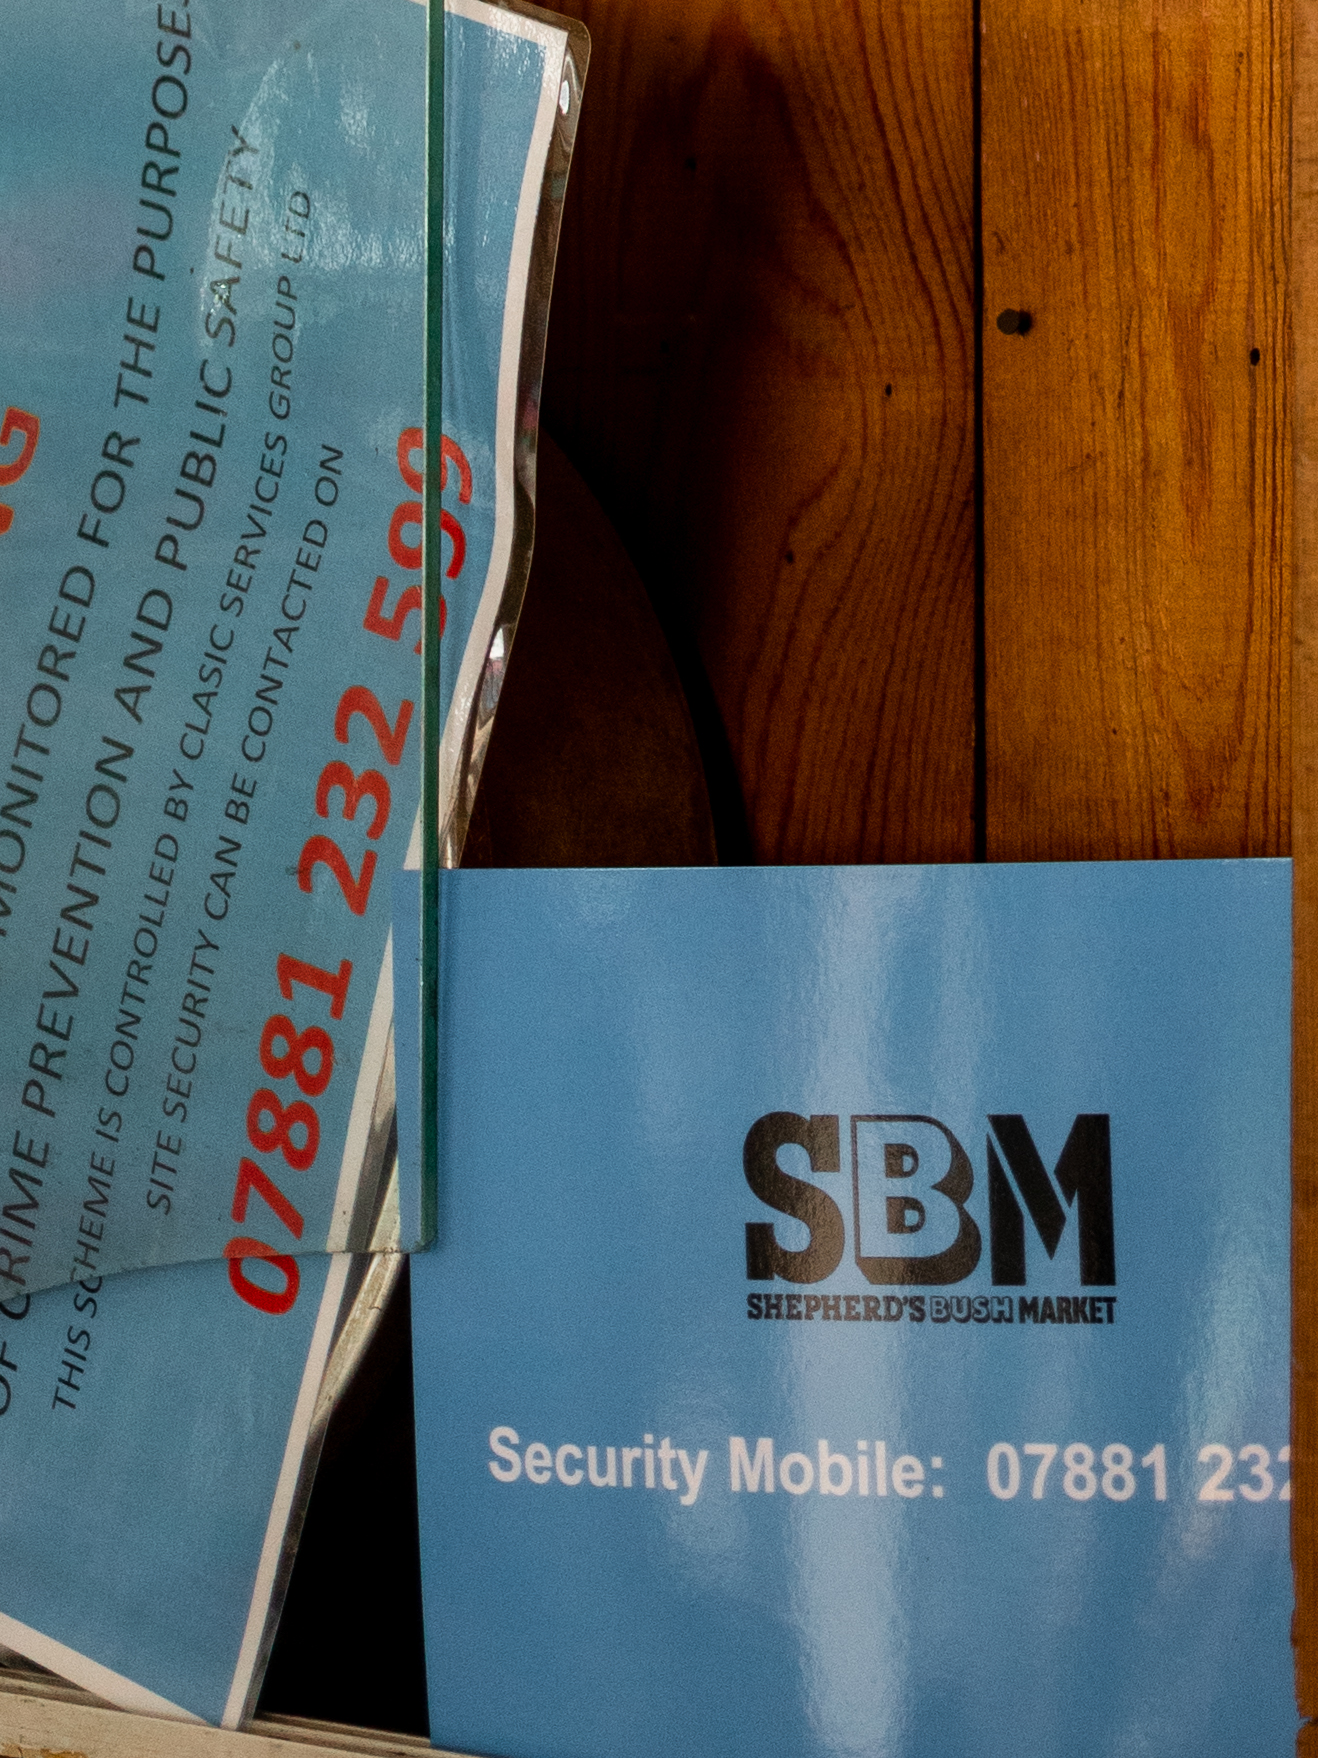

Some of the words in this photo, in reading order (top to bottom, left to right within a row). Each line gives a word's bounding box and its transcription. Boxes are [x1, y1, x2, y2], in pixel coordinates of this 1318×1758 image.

[281, 191, 311, 264] LTD
[268, 275, 298, 421] GROUP
[77, 431, 141, 548] FOR
[113, 297, 163, 408] THE
[315, 443, 344, 506] ON
[219, 431, 288, 617] SERVICES
[21, 735, 135, 1118] PREVENTION
[114, 588, 174, 724] AND
[154, 358, 233, 571] PUBLIC
[204, 124, 259, 348] SAFETY
[242, 519, 330, 763] CONTACTED
[180, 623, 235, 761] CLASIC
[163, 769, 195, 822] BY
[224, 772, 258, 825] BE
[204, 834, 242, 921] CAN
[223, 950, 355, 1315] 07881
[297, 685, 414, 916] 232
[363, 427, 473, 655] 599
[105, 833, 180, 1097] CONTROLLED
[162, 929, 221, 1123] SECURITY
[95, 1106, 124, 1142] IS
[147, 1130, 182, 1216] SITE
[69, 1149, 117, 1319] SCHEME
[742, 1111, 1117, 1287] SBM
[52, 1325, 92, 1410] THIS
[746, 1292, 928, 1324] SHEPHERD'S
[929, 1295, 1014, 1324] BUSH
[1018, 1295, 1118, 1325] MARKET
[488, 1425, 709, 1506] Security
[729, 1436, 945, 1499] Mobile:
[987, 1442, 1168, 1502] 07881
